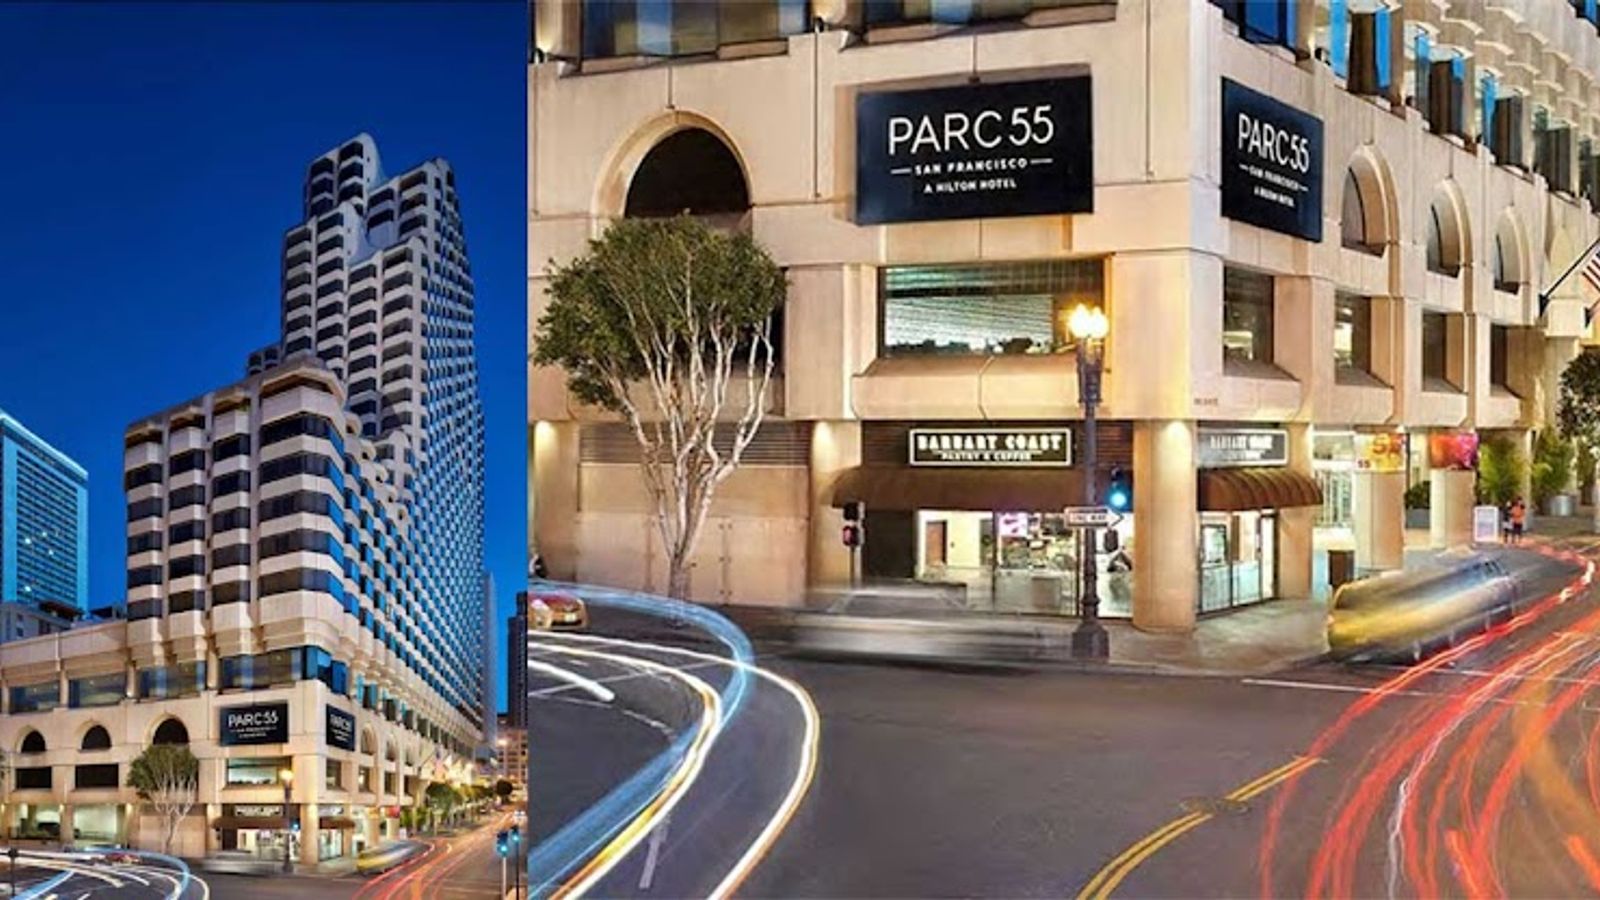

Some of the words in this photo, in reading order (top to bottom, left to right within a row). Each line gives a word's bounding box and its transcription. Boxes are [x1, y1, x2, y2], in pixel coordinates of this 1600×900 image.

[888, 110, 1002, 156] PARC
[1008, 104, 1054, 146] 55
[1238, 112, 1290, 166] PARC
[1289, 134, 1310, 174] 55
[914, 163, 942, 176] SAN
[947, 157, 1028, 174] FRANCISCO
[923, 183, 933, 194] A
[936, 180, 977, 193] HILTON
[980, 177, 1017, 190] HOTEL
[917, 434, 999, 450] BARBARY
[1004, 434, 1063, 450] COAST
[228, 712, 263, 728] PARC
